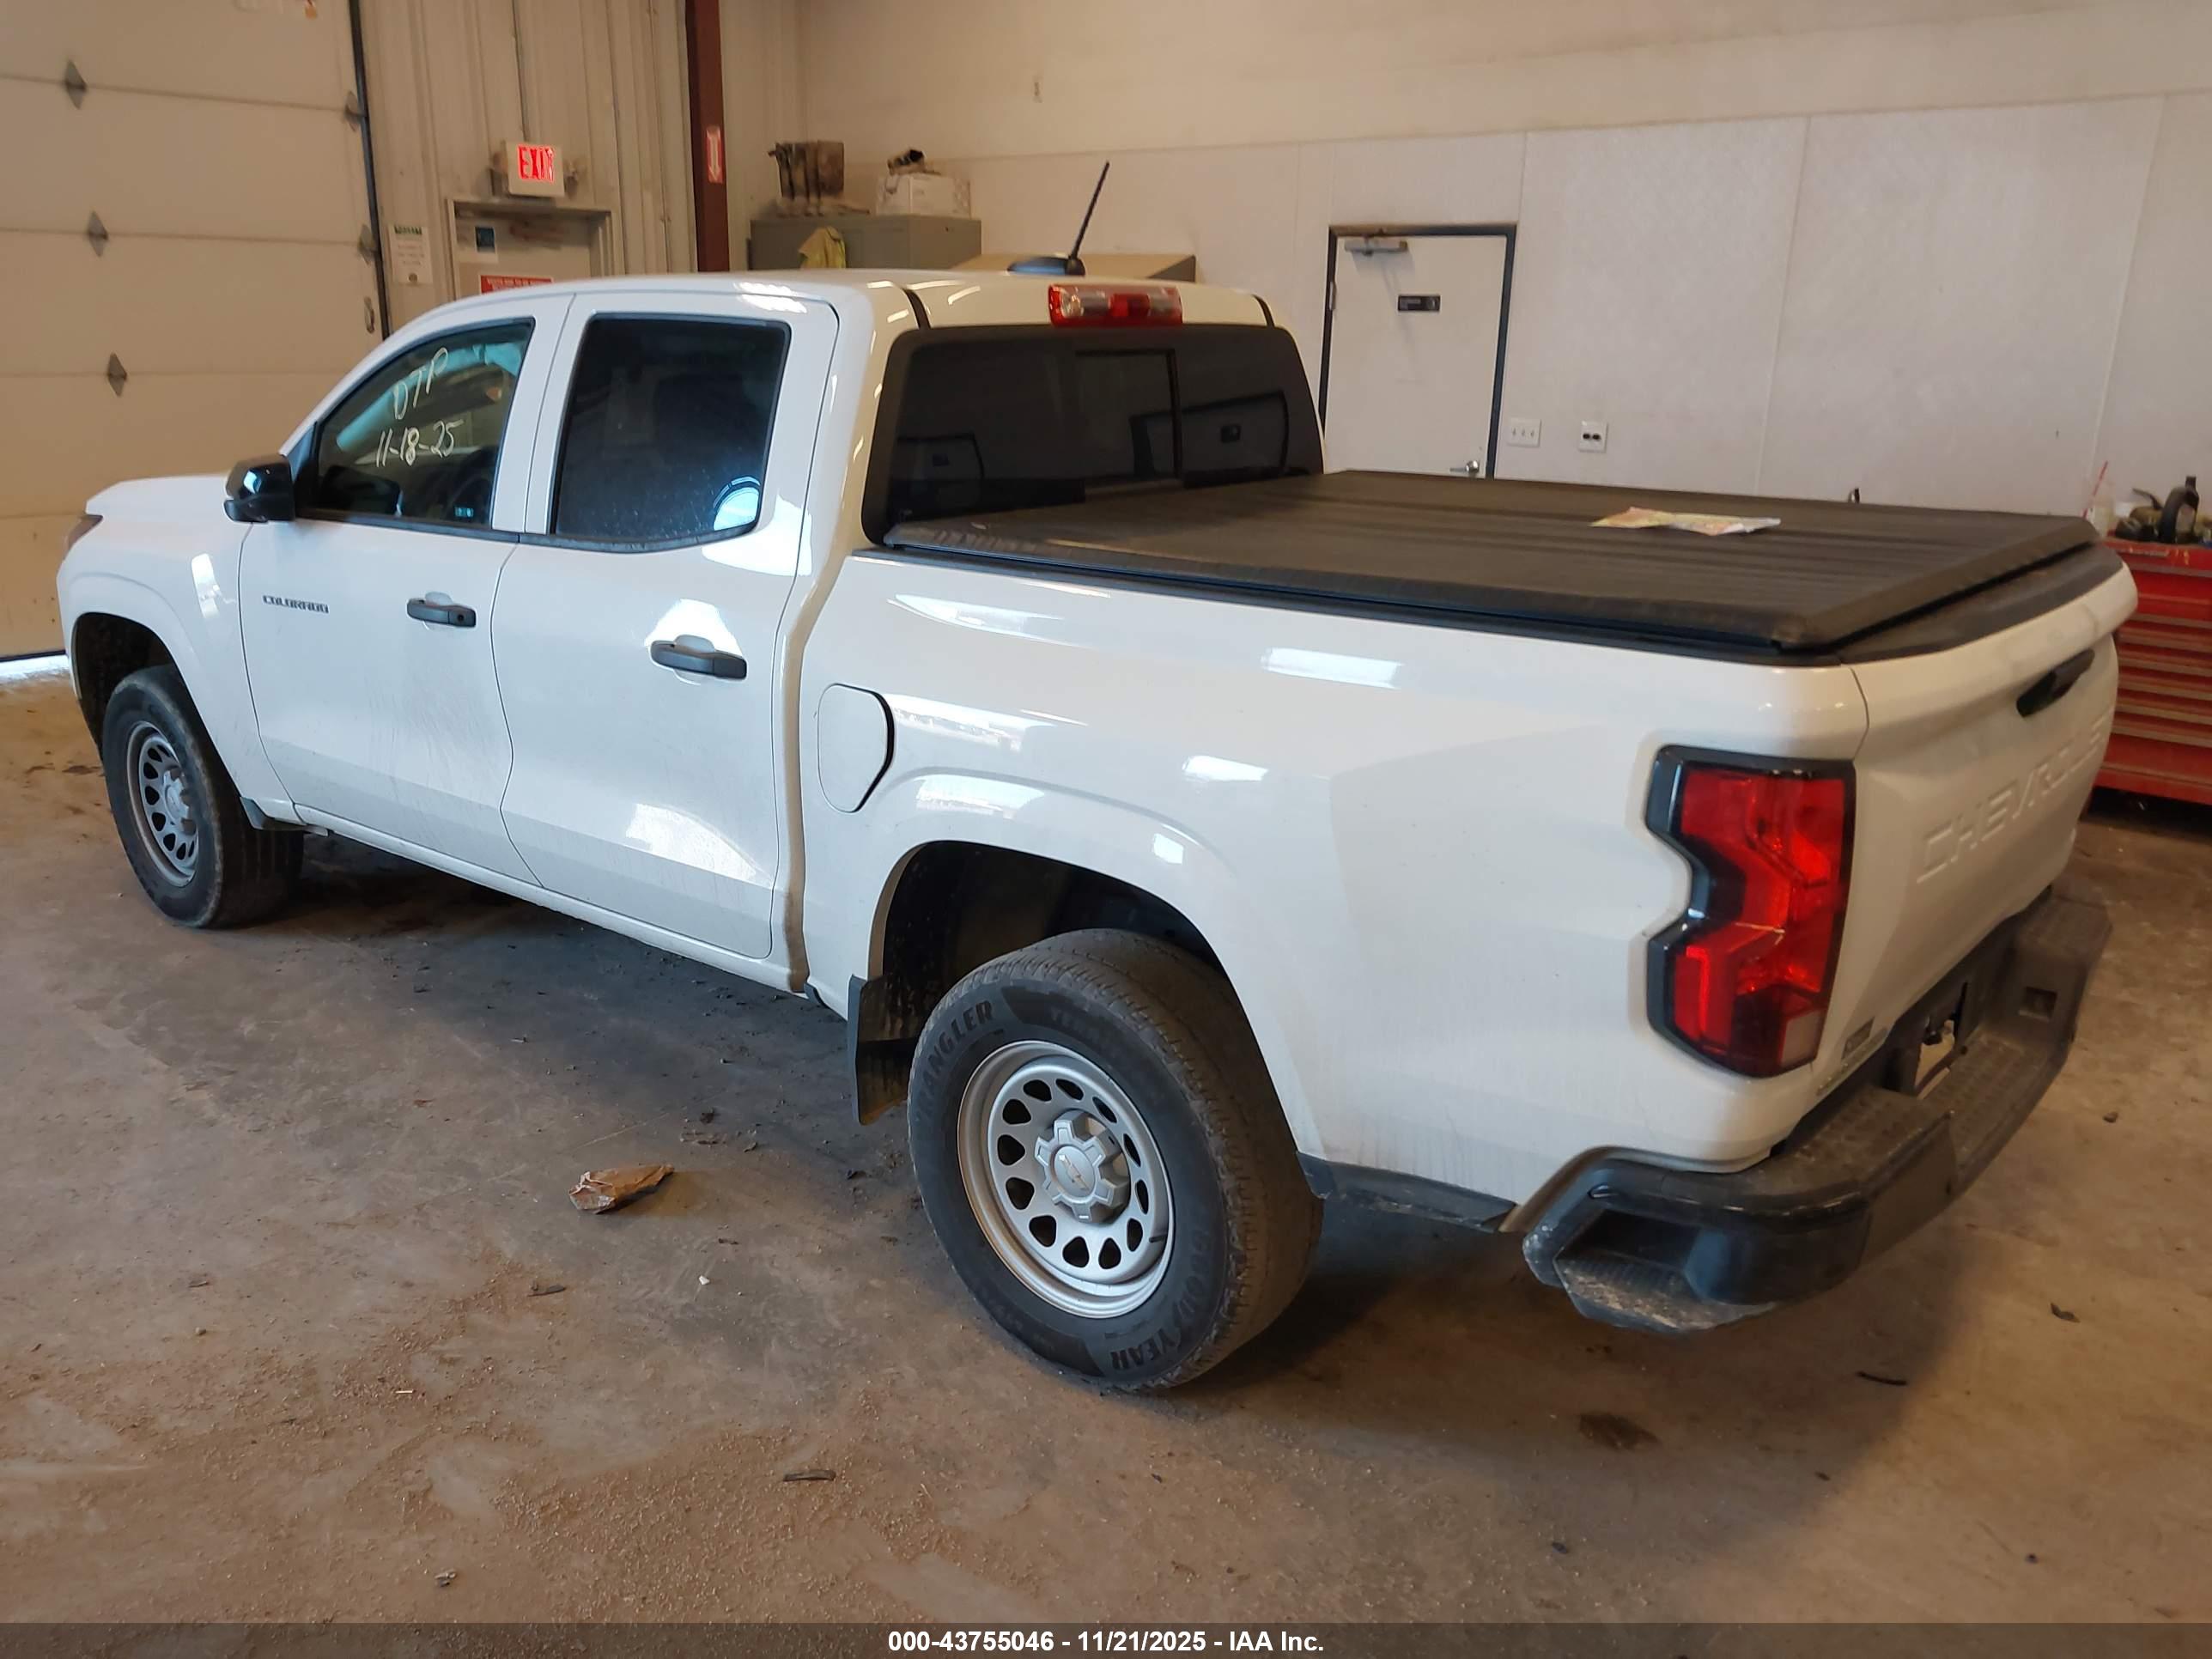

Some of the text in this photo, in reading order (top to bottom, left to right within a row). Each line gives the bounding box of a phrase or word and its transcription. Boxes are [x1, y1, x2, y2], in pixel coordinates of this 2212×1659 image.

[518, 144, 554, 182] EXIT
[376, 419, 465, 468] 11-18-25
[262, 595, 330, 614] COLORADO
[914, 1000, 994, 1125] RANGLER
